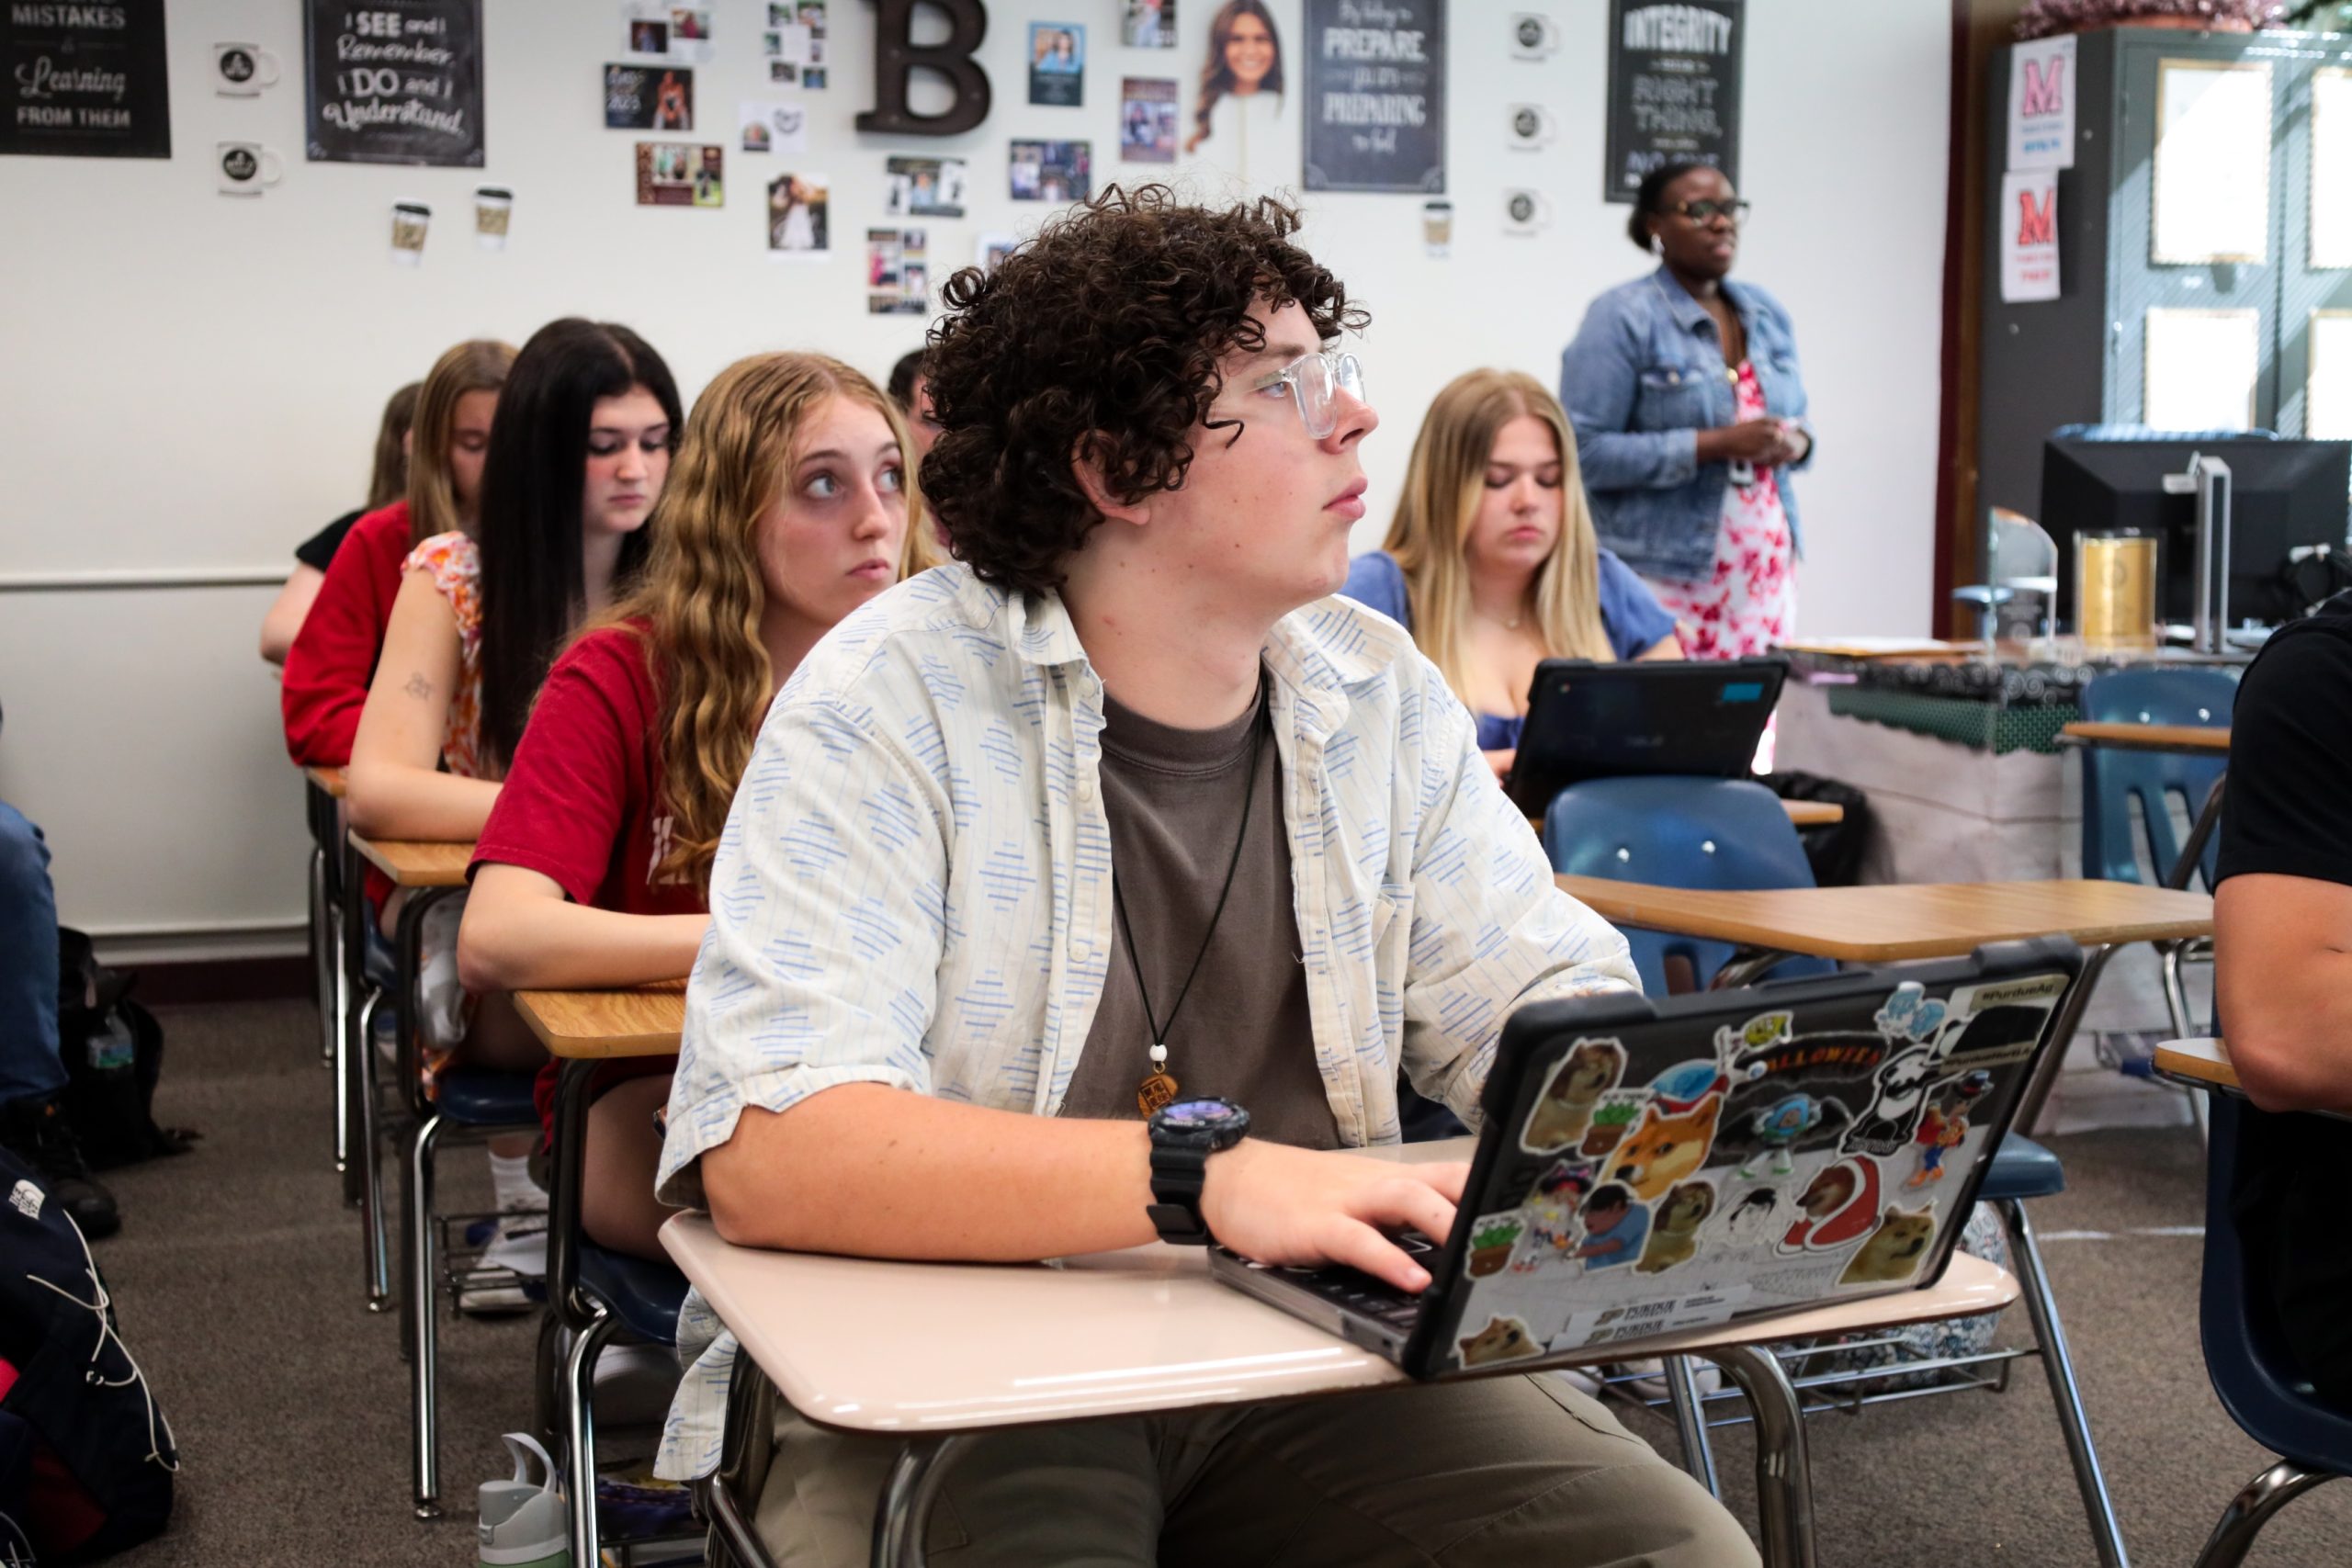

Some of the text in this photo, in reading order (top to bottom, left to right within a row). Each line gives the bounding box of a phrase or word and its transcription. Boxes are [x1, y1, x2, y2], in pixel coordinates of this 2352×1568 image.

[12, 4, 126, 28] MISTAKES
[345, 12, 353, 30] I
[356, 11, 401, 38] SEE
[404, 17, 437, 34] and
[1623, 4, 1734, 55] INTEGRITY
[15, 55, 127, 103] Learning
[855, 0, 991, 136] B
[337, 67, 453, 100] I DO and I
[1632, 74, 1719, 106] RIGHT
[17, 107, 131, 128] FROM THEM
[1982, 983, 2053, 1001] #PurdueAg
[1766, 1045, 1882, 1074] ALLOWEEN
[1625, 1300, 1677, 1316] PURDUE
[1615, 1319, 1666, 1334] PURDUE
